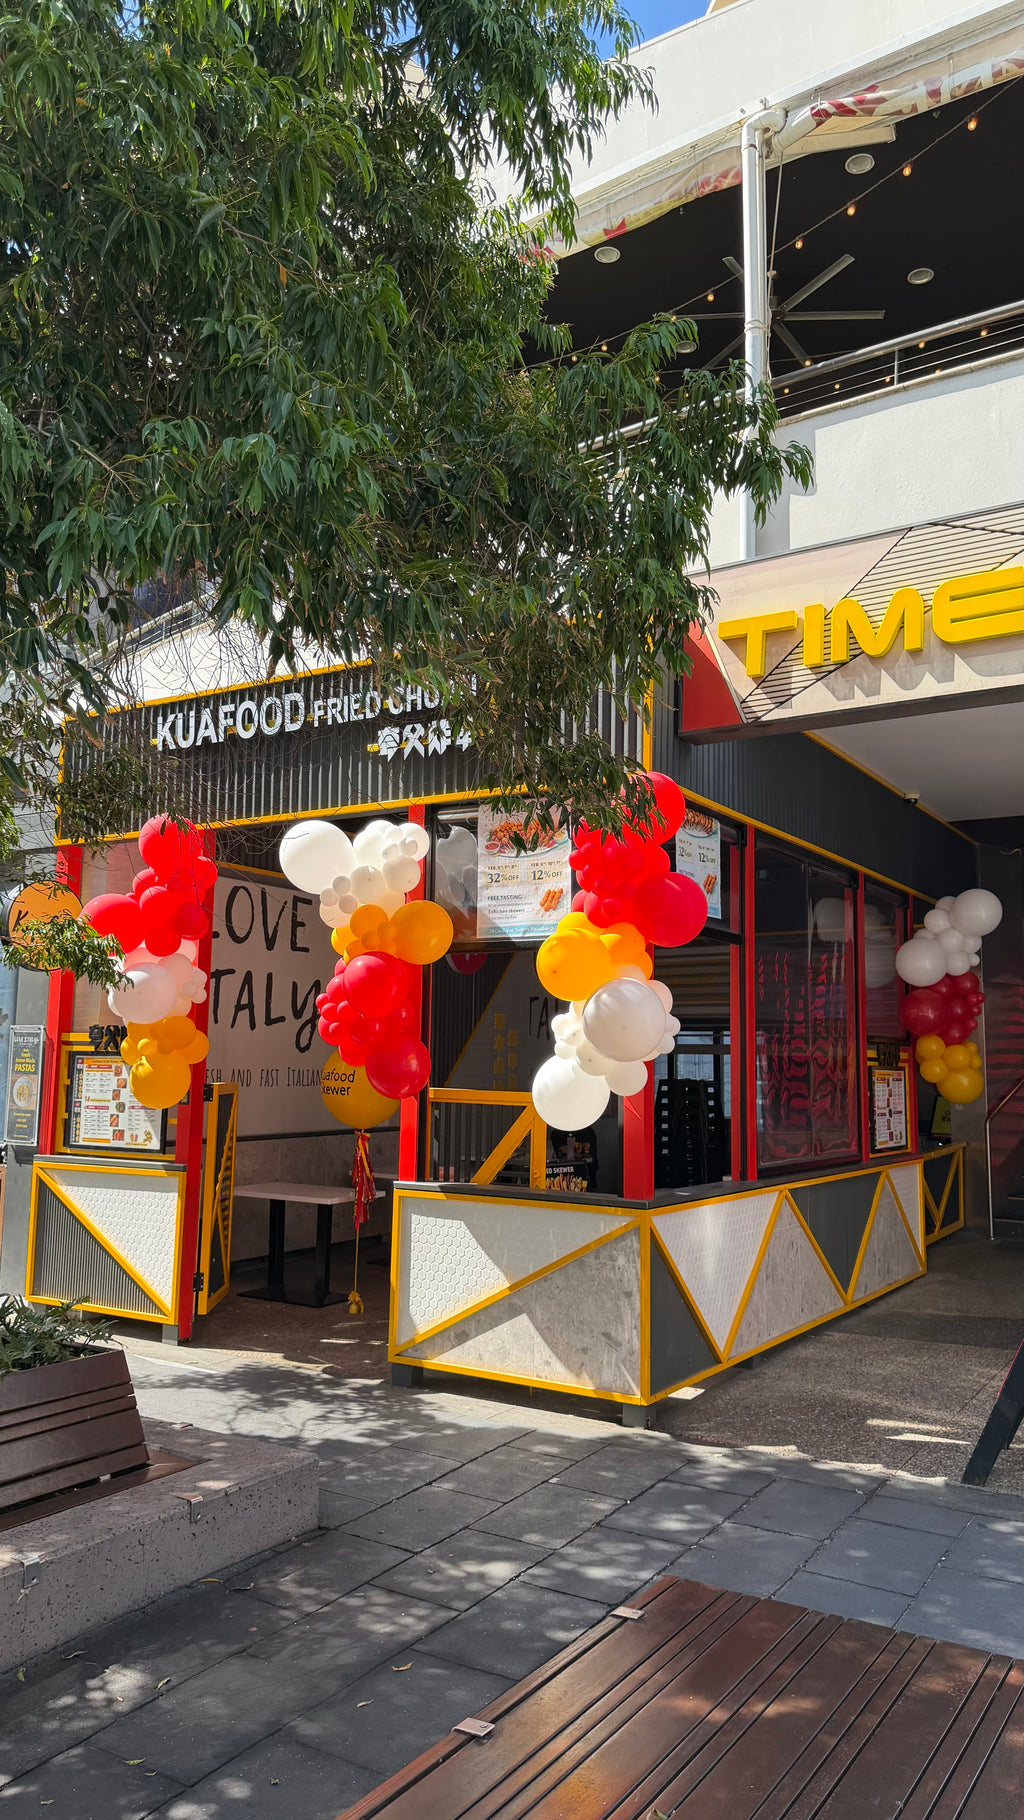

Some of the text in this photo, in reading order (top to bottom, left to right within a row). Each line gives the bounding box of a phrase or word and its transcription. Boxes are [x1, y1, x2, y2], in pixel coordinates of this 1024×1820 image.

[718, 566, 1024, 679] TIME
[157, 692, 305, 752] KUAFOOD
[313, 690, 381, 727] FRIED
[551, 870, 563, 878] OFF
[212, 886, 313, 952] OVE
[14, 1063, 36, 1072] PASTAS
[230, 1068, 252, 1087] AND
[260, 1068, 280, 1087] FAST
[553, 1166, 575, 1174] SKEWER
